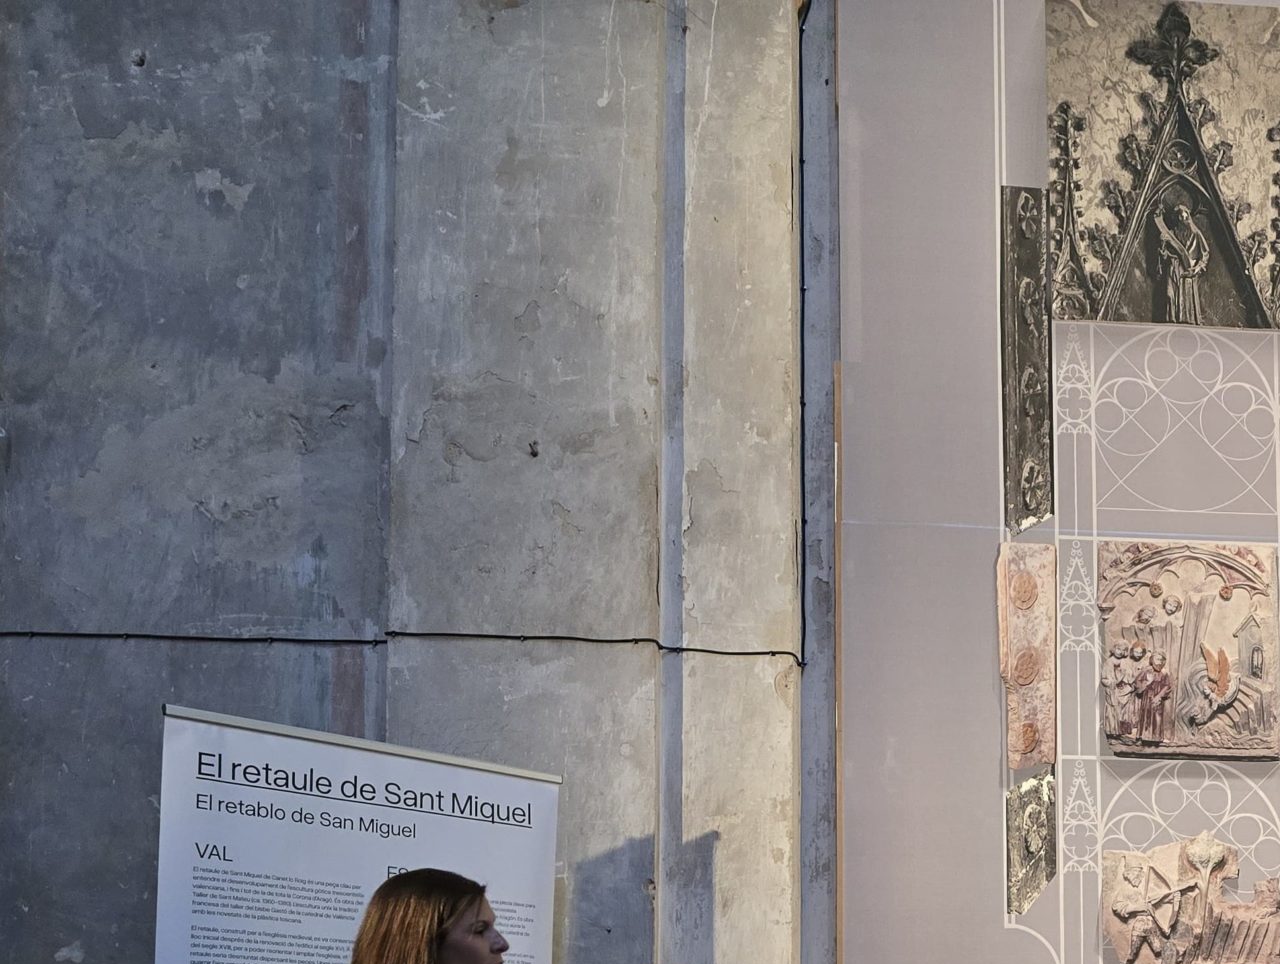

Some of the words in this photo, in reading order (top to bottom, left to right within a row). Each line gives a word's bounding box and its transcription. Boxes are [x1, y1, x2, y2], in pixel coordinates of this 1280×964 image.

[198, 752, 222, 778] El
[231, 762, 332, 794] retaule
[340, 775, 376, 801] de
[385, 782, 444, 811] Sant
[452, 793, 531, 825] Miquel
[196, 793, 212, 811] El
[218, 799, 285, 820] retablo
[291, 807, 315, 824] de
[320, 811, 354, 830] San
[359, 817, 416, 838] Miguel
[195, 842, 233, 862] VAL
